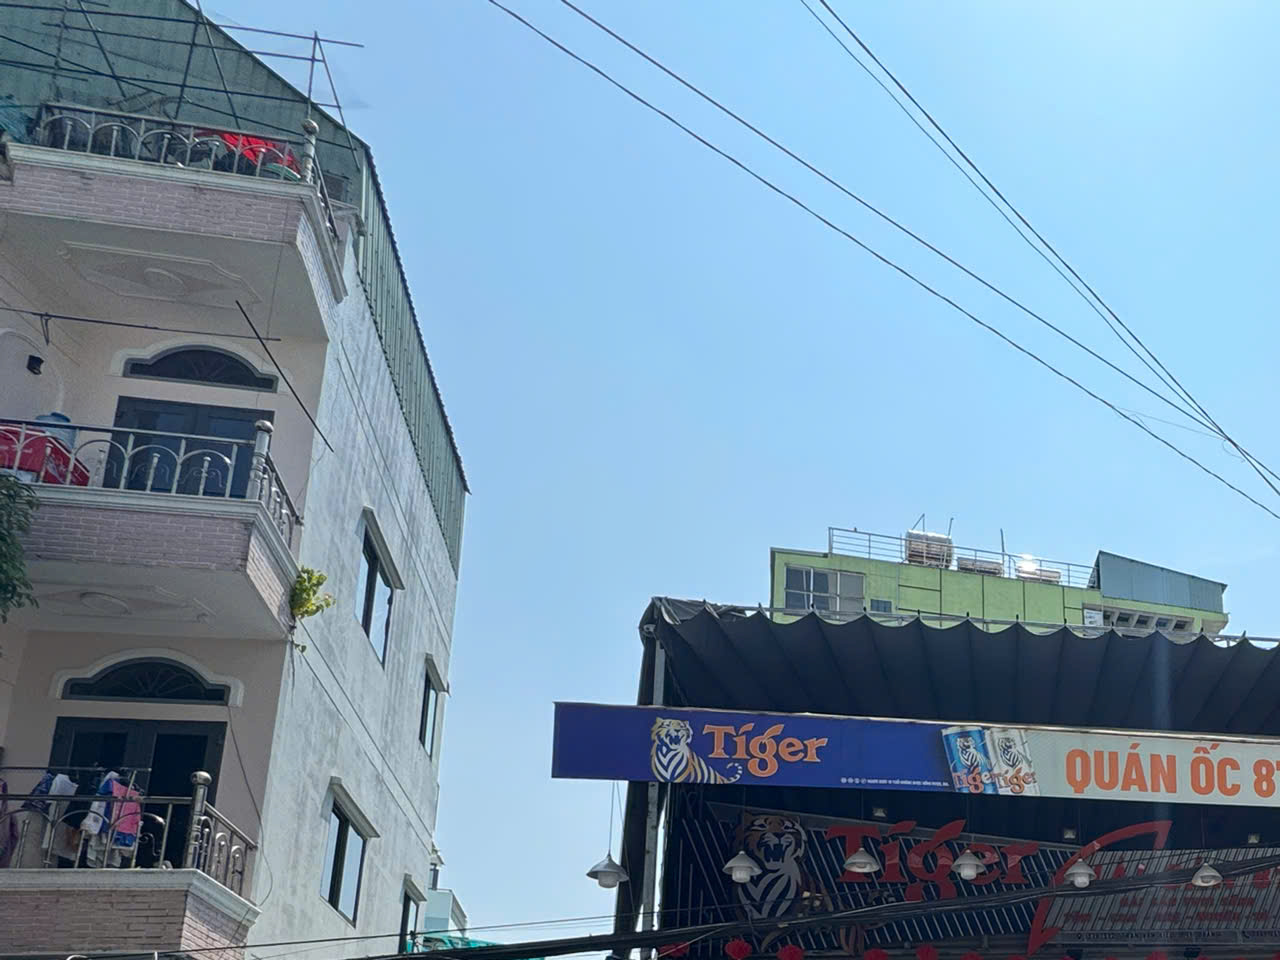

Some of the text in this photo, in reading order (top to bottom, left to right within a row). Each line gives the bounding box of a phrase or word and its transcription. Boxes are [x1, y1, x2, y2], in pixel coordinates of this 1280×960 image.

[703, 722, 829, 777] Tiger
[1065, 743, 1177, 794] QUÁN
[1190, 743, 1241, 797] ỐC
